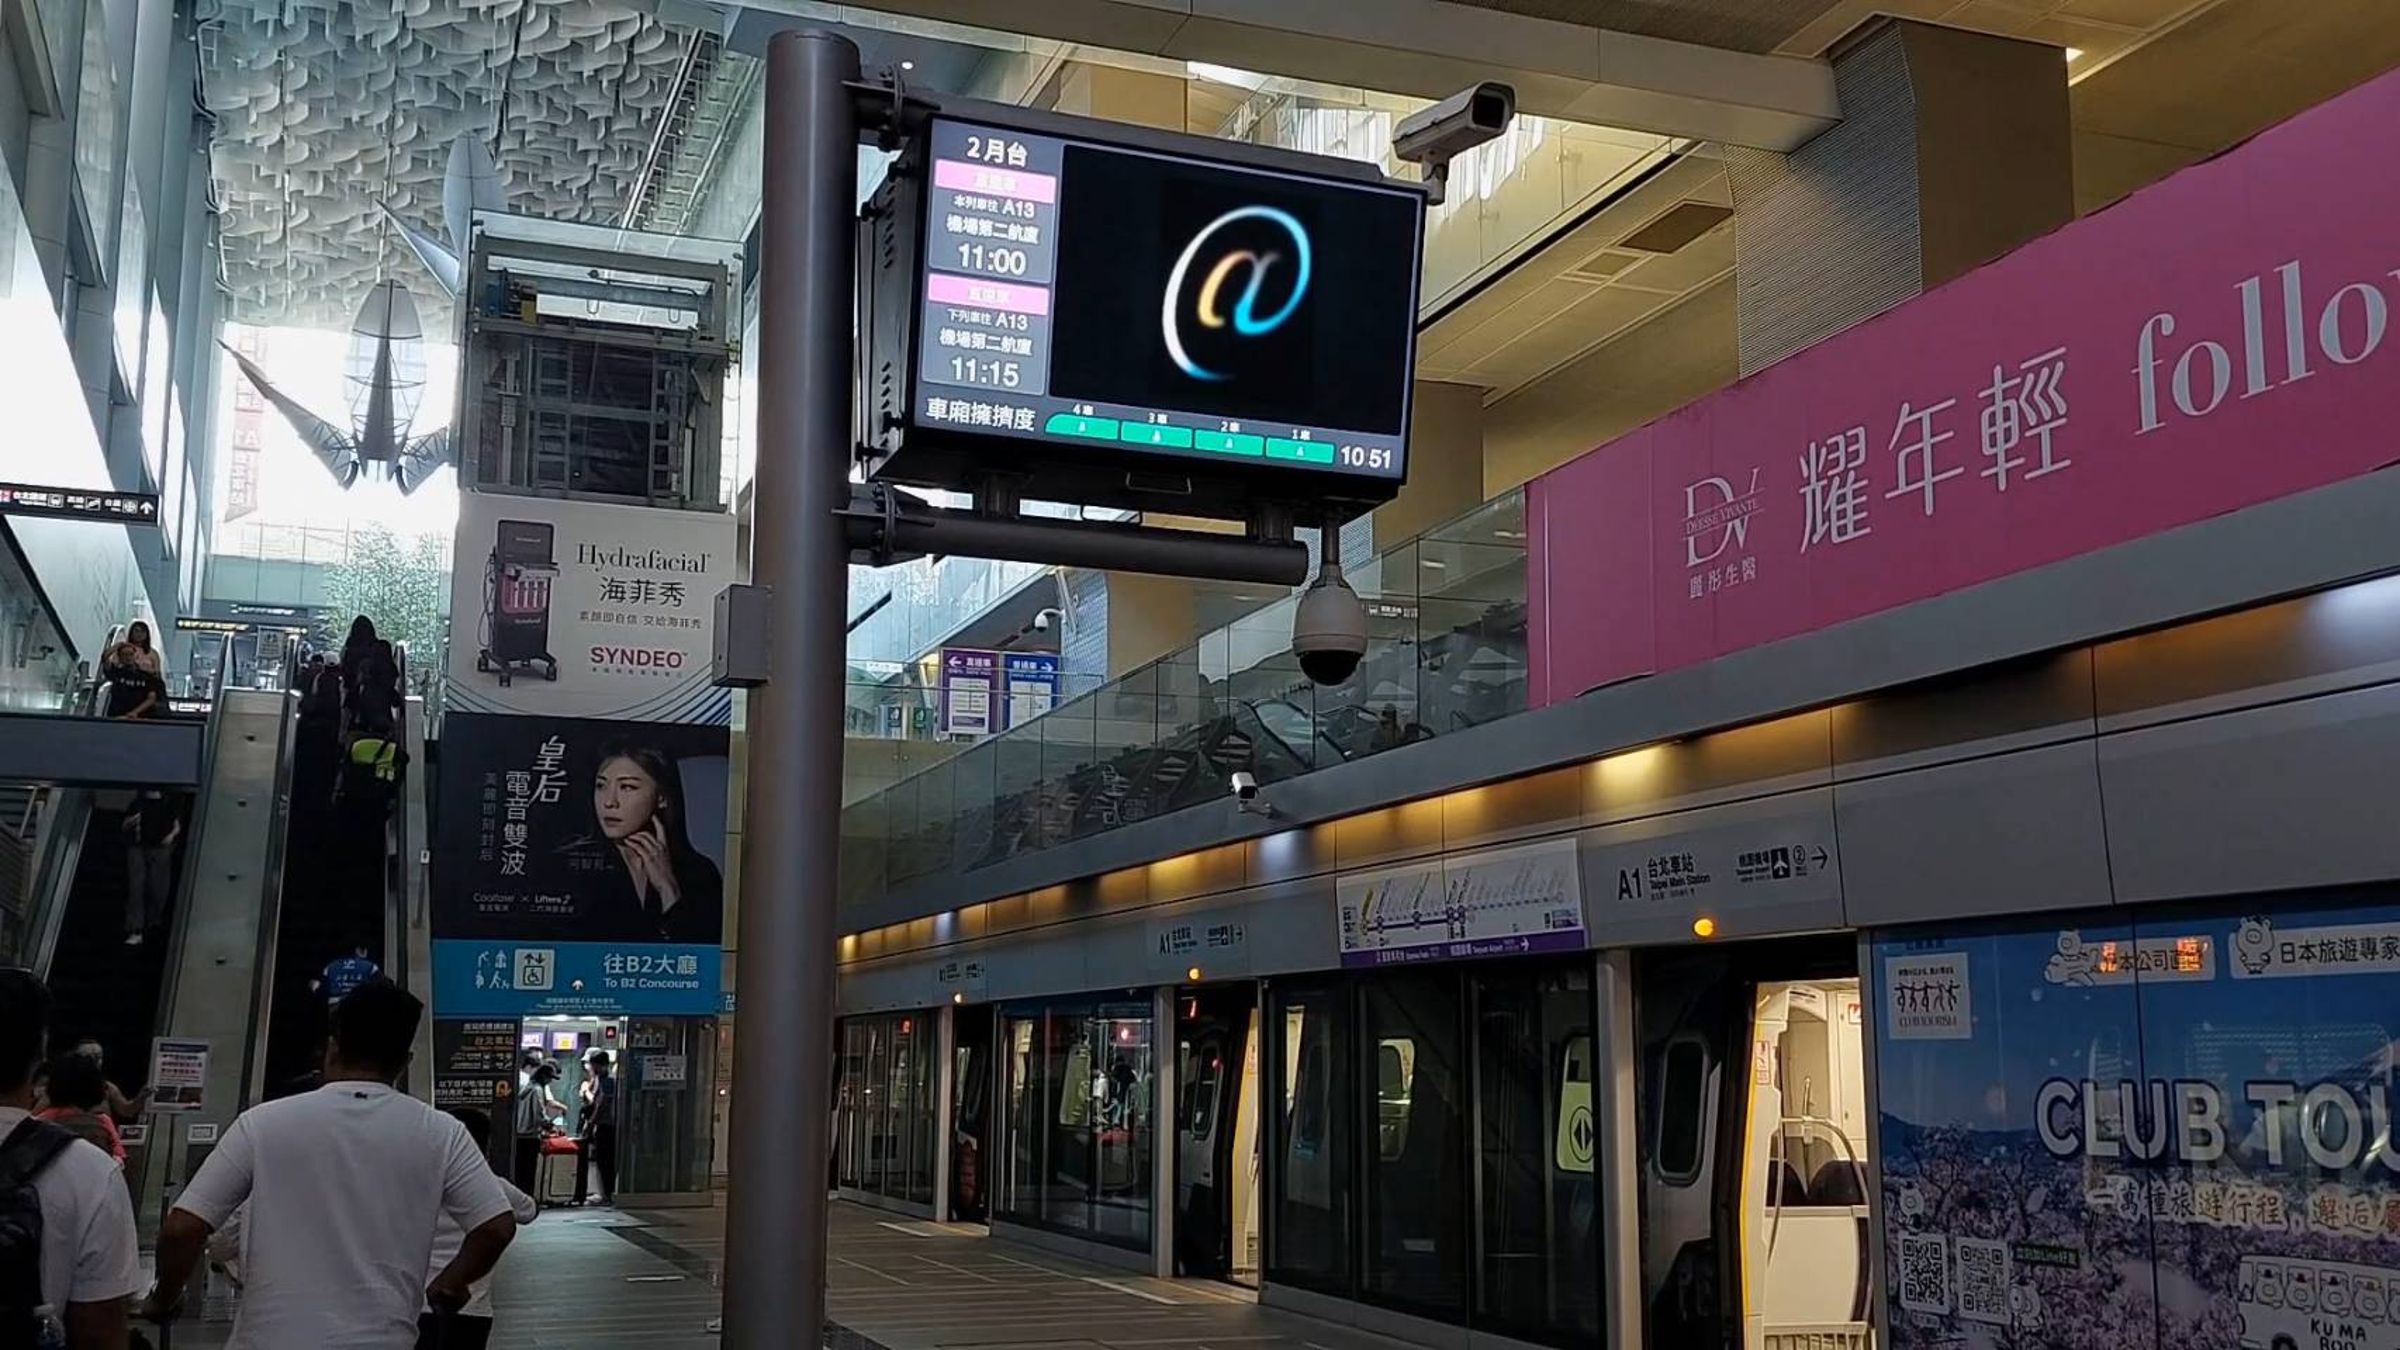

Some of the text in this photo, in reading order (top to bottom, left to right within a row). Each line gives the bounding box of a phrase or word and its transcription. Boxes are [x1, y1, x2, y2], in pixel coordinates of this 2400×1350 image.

[1002, 199, 1035, 219] A13
[958, 243, 1026, 275] 11:00
[995, 312, 1028, 331] A13
[951, 356, 1020, 388] 11:15
[926, 397, 1036, 432] 車廂擁擠度
[1800, 259, 2400, 554] 耀年輕 follo
[577, 543, 707, 574] Hydrafacial
[600, 577, 685, 608] 海菲秀
[591, 646, 682, 669] SYNDEO
[527, 735, 568, 806] 皇后
[501, 770, 530, 876] 電音雙波
[1647, 852, 1695, 878] 台北車站
[1618, 867, 1643, 901] A1
[604, 953, 698, 974] 往B2大廳
[2034, 1077, 2227, 1163] CLUB
